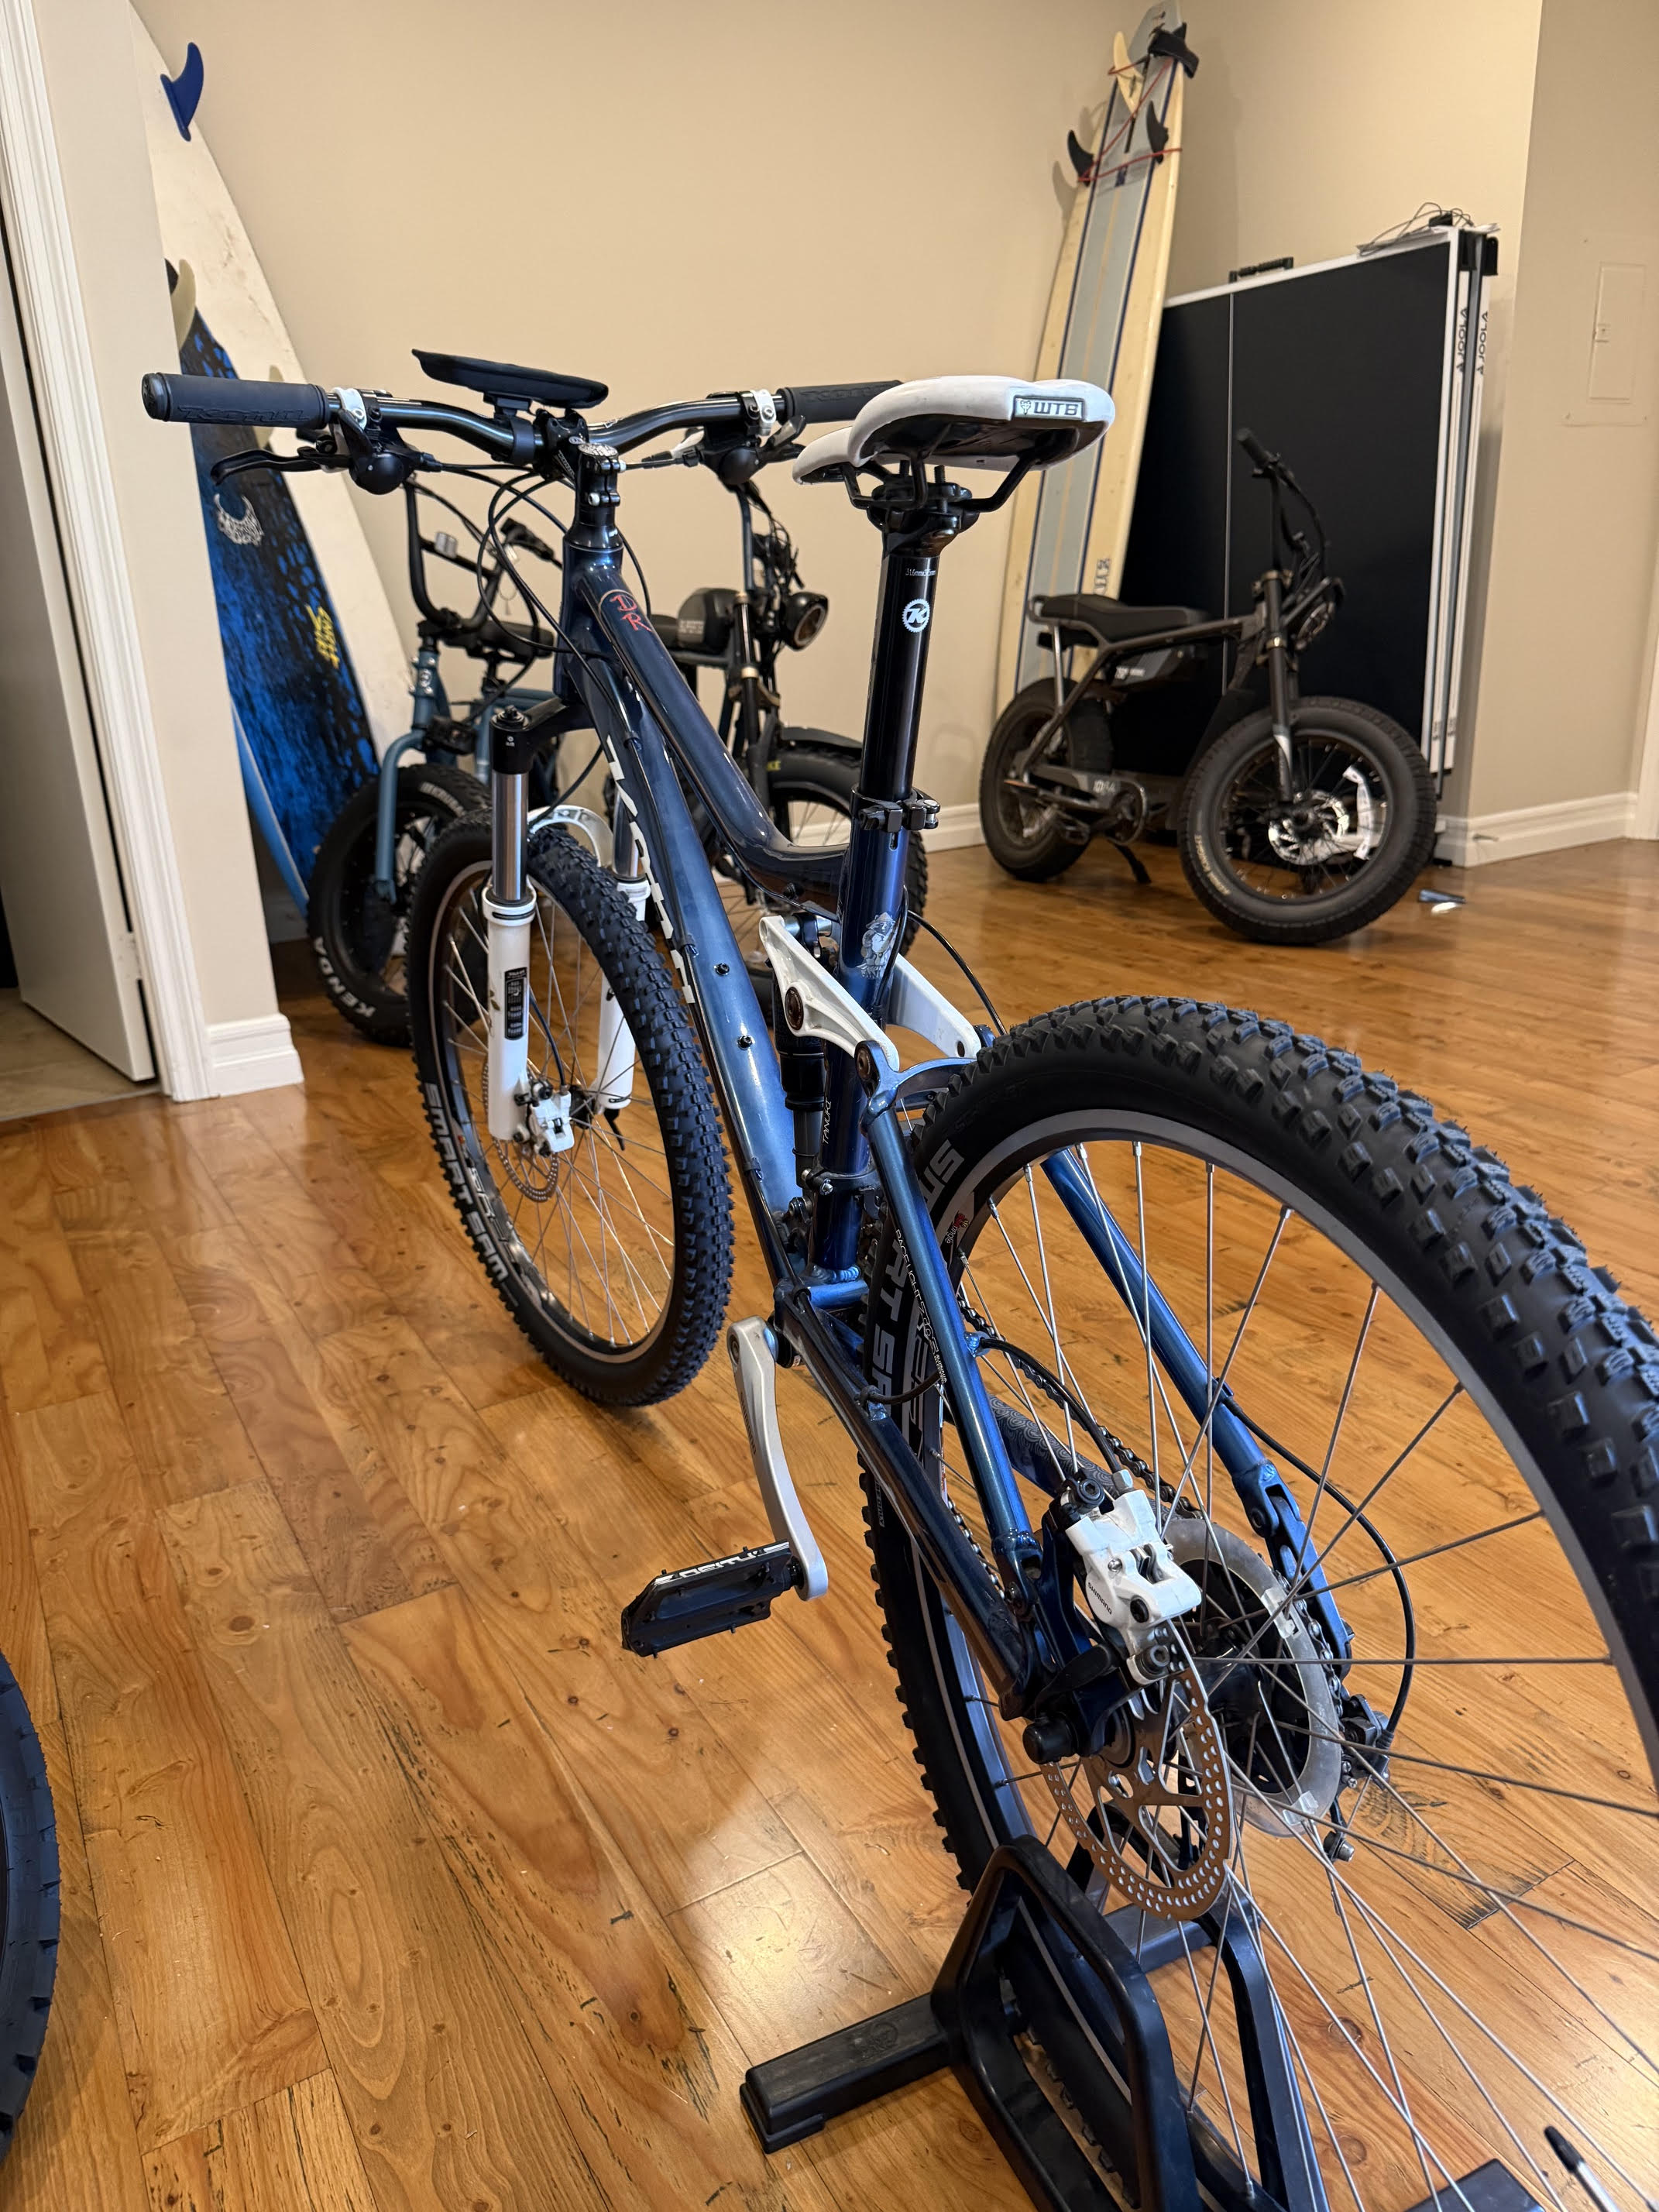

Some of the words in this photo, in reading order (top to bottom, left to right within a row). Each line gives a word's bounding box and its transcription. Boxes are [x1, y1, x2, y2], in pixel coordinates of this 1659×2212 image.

[1457, 307, 1469, 359] JOOLA
[1476, 311, 1488, 362] JOOLA
[1033, 401, 1079, 416] WTB
[313, 936, 376, 1018] KENDA
[823, 1097, 833, 1145] TANUKI
[425, 1083, 473, 1206] SMART
[466, 1211, 509, 1281] SAM
[895, 1228, 909, 1258] RACE
[905, 1258, 923, 1300] LIGHT
[1087, 1582, 1113, 1616] SHIMANO
